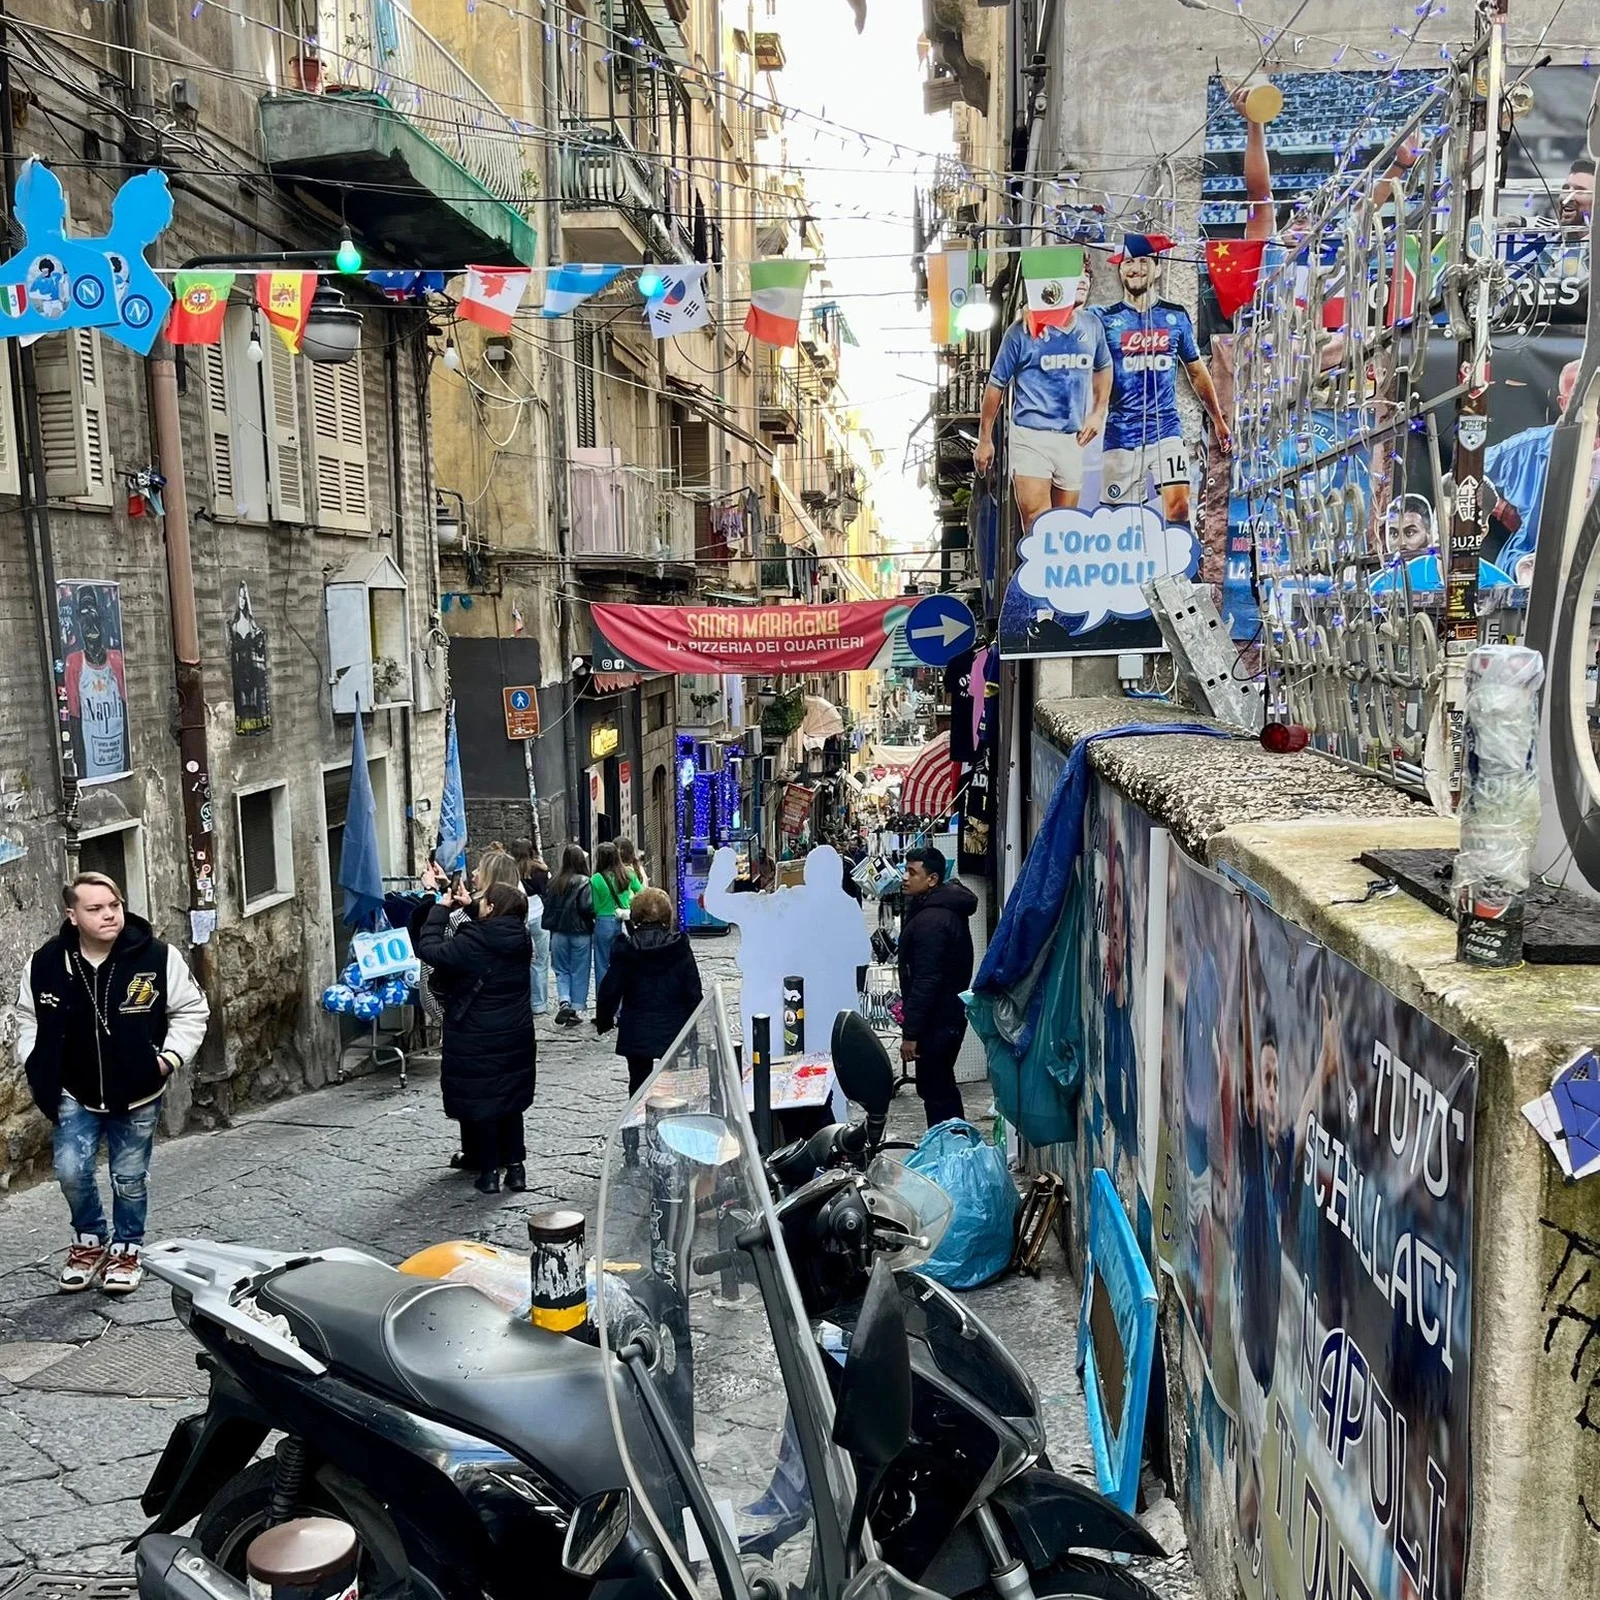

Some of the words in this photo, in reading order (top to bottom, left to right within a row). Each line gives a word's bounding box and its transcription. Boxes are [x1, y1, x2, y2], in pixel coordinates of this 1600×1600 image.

[10, 295, 17, 307] 3
[1121, 331, 1169, 351] Lete
[1166, 455, 1186, 479] 14
[1043, 530, 1111, 555] L'Oro
[1117, 525, 1143, 552] di
[1044, 561, 1156, 589] NAPOLI!
[667, 641, 685, 651] LA
[688, 641, 753, 653] PIZZERIA
[756, 641, 780, 653] DEI
[784, 637, 864, 652] QUARTIERI
[1304, 1112, 1457, 1374] SCHILLACI
[1299, 1272, 1447, 1600] NAPOLI
